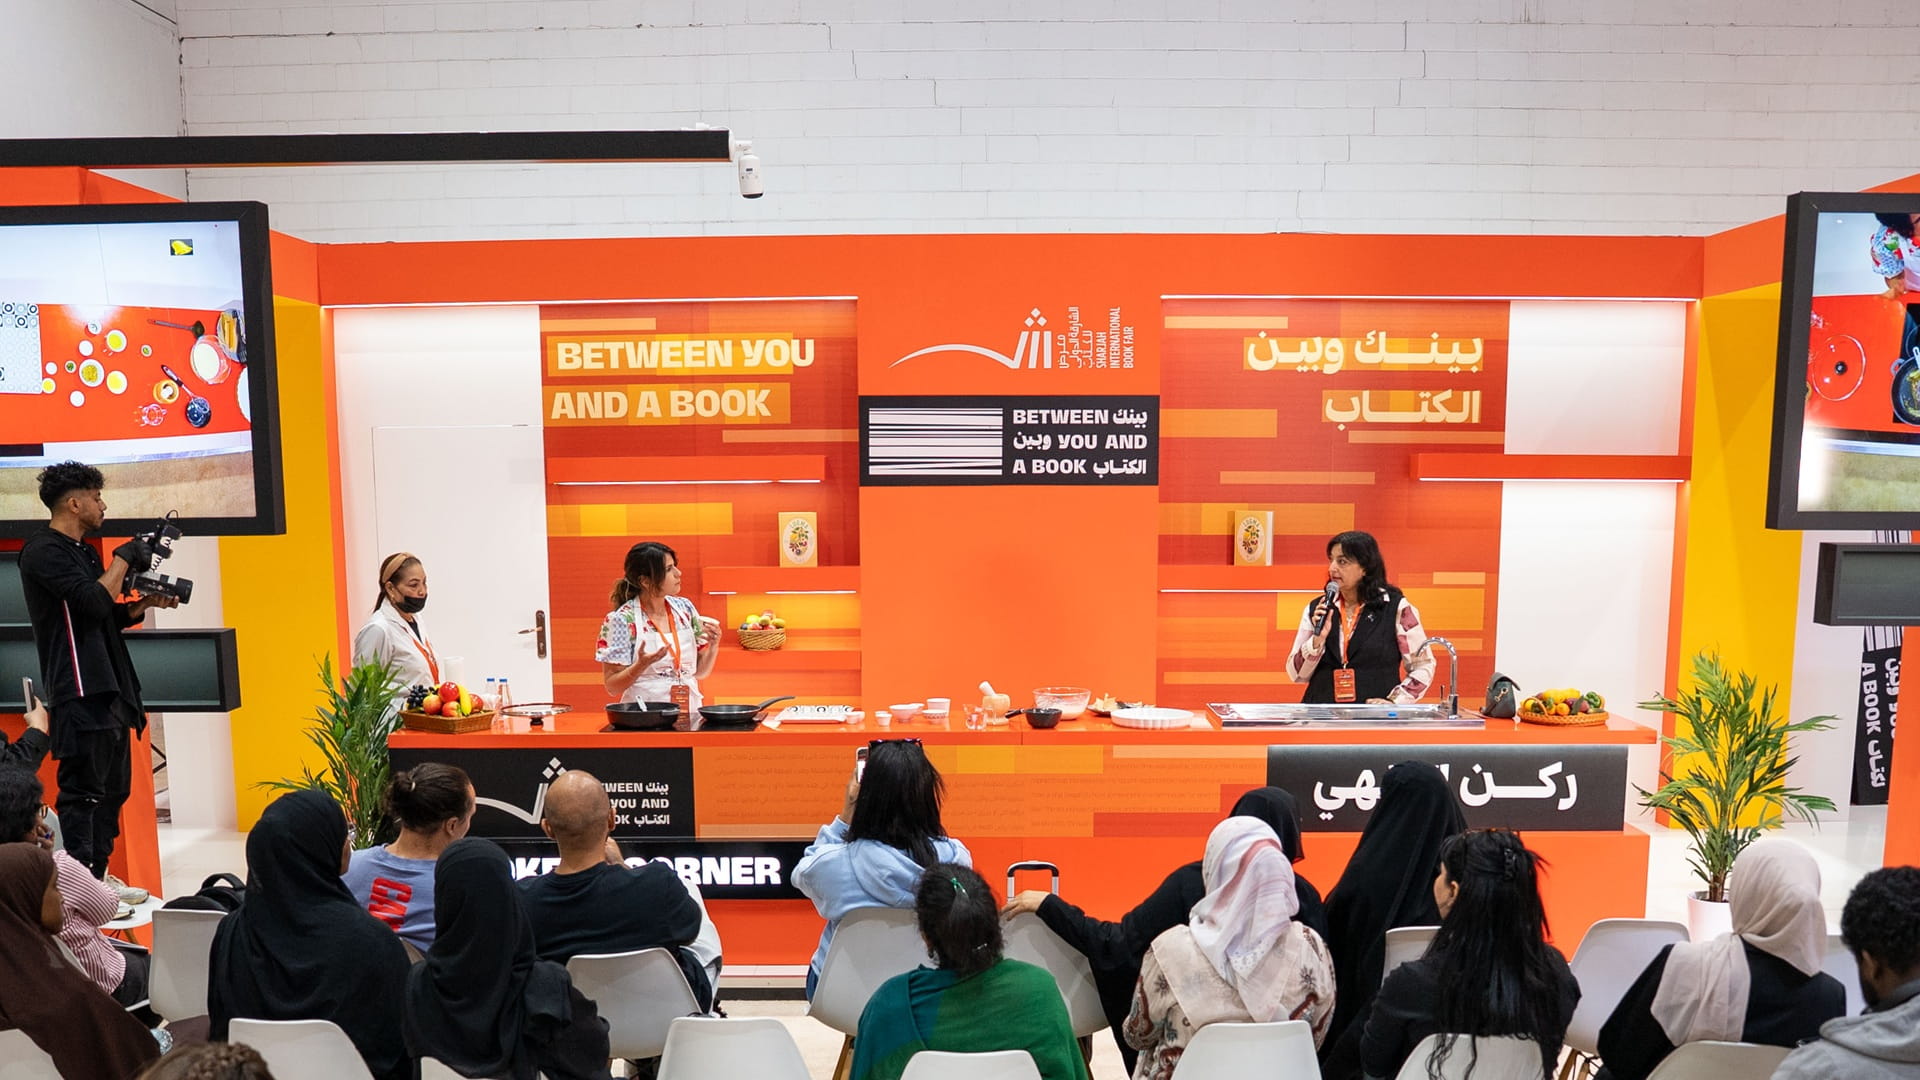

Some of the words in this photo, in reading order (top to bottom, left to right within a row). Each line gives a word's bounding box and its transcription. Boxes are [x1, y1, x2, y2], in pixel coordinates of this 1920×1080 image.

[1109, 306, 1121, 369] INTERNATIONAL
[1123, 326, 1134, 345] FAIR
[557, 340, 732, 370] BETWEEN
[741, 338, 815, 367] YOU
[1095, 332, 1107, 369] SHARJAH
[1123, 346, 1134, 369] BOOK
[1247, 331, 1344, 374] وبين
[1354, 330, 1483, 373] بينك
[551, 391, 629, 420] AND
[636, 390, 662, 418] A
[669, 389, 771, 418] BOOK
[1325, 389, 1481, 431] الكتاب
[1012, 409, 1109, 424] BETWEEN
[1112, 409, 1148, 428] بينك
[1012, 432, 1052, 450] وبين
[1058, 434, 1098, 449] YOU
[1105, 434, 1147, 449] AND
[1012, 459, 1026, 474] A
[1032, 459, 1087, 474] BOOK
[1093, 459, 1148, 478] الكتاب
[1862, 662, 1876, 677] A
[1863, 680, 1881, 735] BOOK
[645, 782, 669, 795] بينك
[1460, 761, 1578, 811] ركن
[610, 798, 636, 808] YOU
[641, 798, 669, 808] AND
[634, 814, 670, 827] الكتاب
